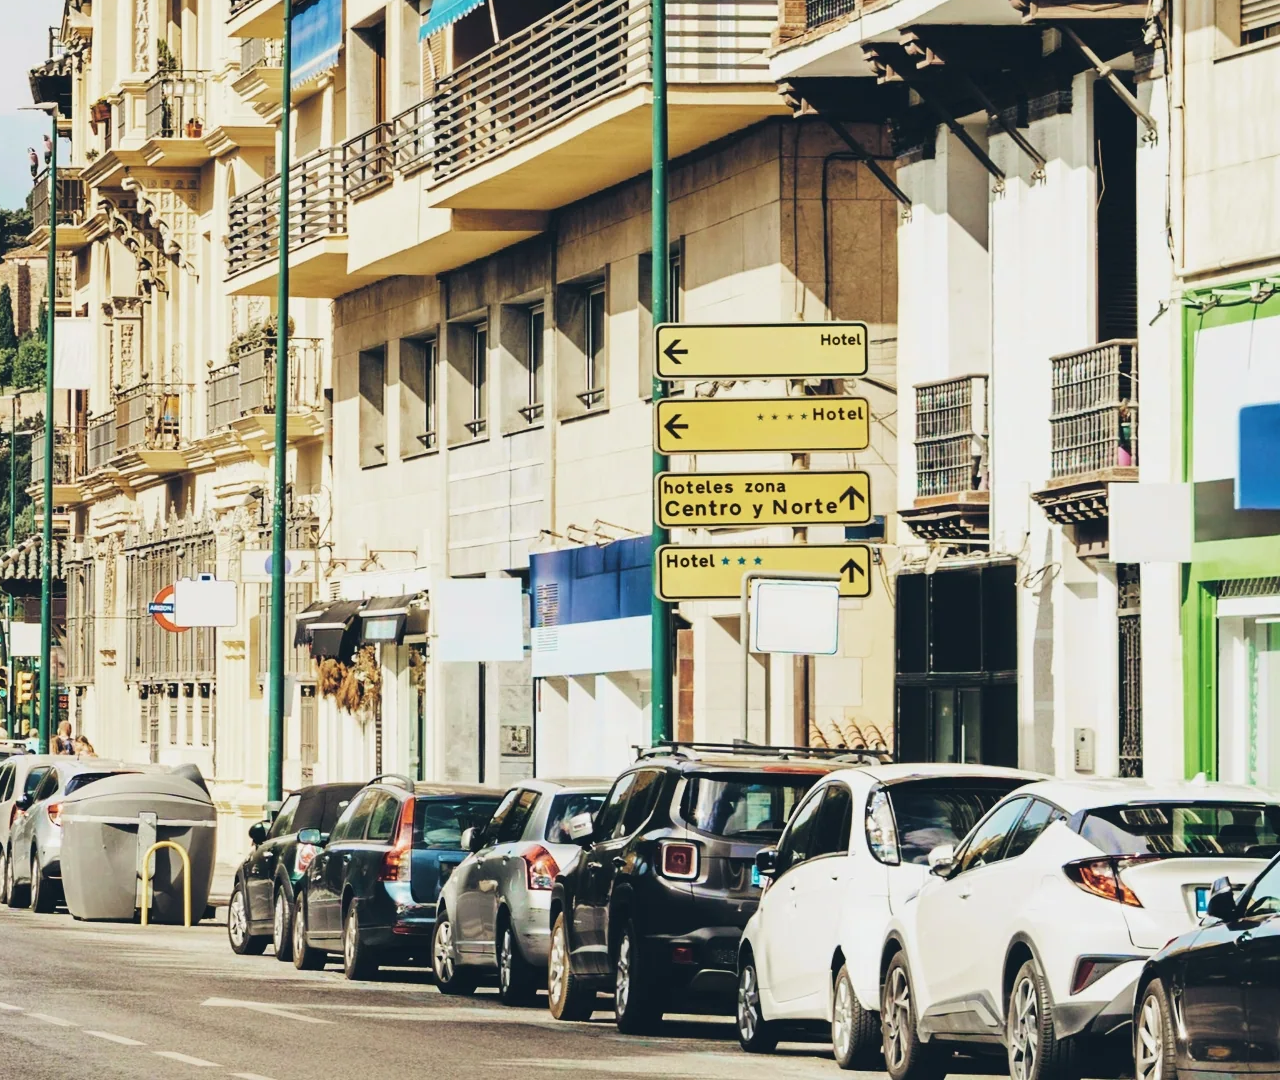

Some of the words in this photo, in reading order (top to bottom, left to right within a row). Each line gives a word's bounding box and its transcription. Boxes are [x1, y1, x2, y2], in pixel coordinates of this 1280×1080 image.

[820, 333, 862, 346] Hotel
[812, 406, 864, 421] Hotel
[663, 480, 734, 494] hoteles
[744, 482, 786, 493] zona
[664, 500, 742, 517] Centro
[752, 504, 764, 519] y
[772, 498, 838, 515] Norte
[666, 553, 716, 568] Hotel
